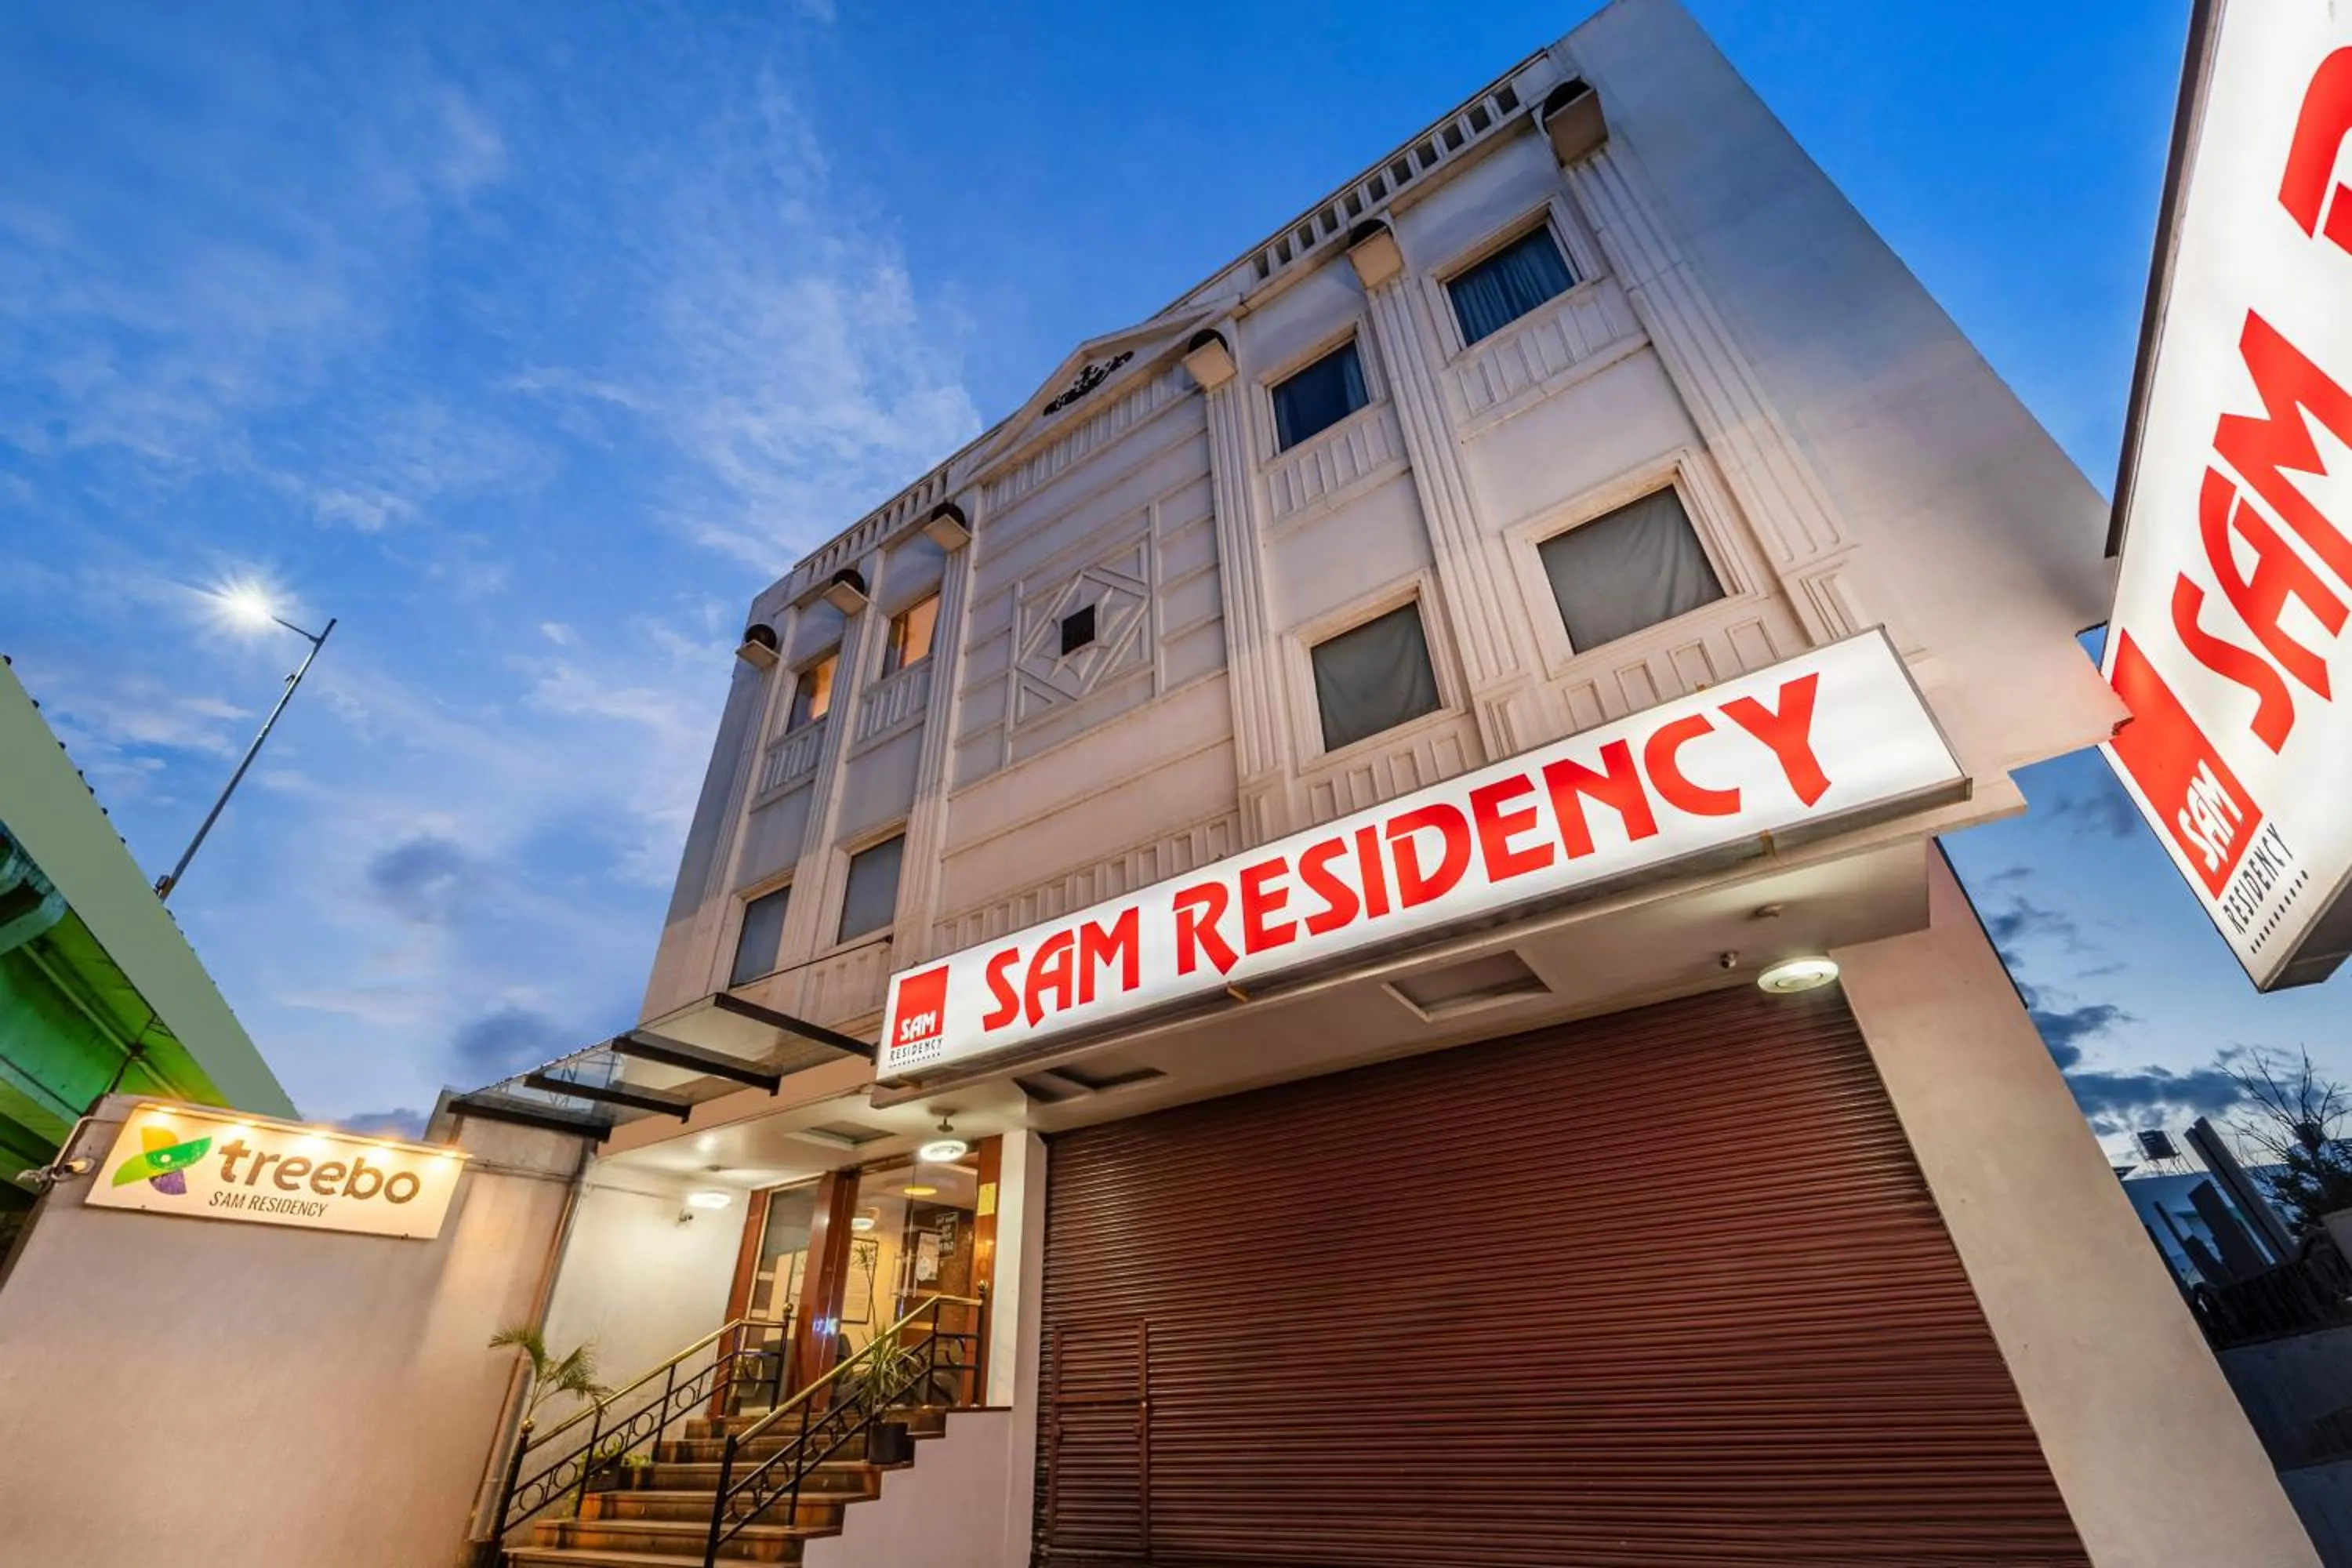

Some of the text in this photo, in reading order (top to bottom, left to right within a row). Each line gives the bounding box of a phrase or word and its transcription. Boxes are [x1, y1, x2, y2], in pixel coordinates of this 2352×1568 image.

[2172, 307, 2352, 756] SAM
[982, 672, 1832, 1032] SAM RESIDENCY
[2177, 758, 2245, 874] SAM
[2223, 822, 2293, 935] RESIDENCY
[890, 1037, 944, 1062] RESIDENCY
[899, 1010, 938, 1042] SAM
[209, 1191, 328, 1218] SAM RESIDENCY
[217, 1138, 420, 1204] treebo
